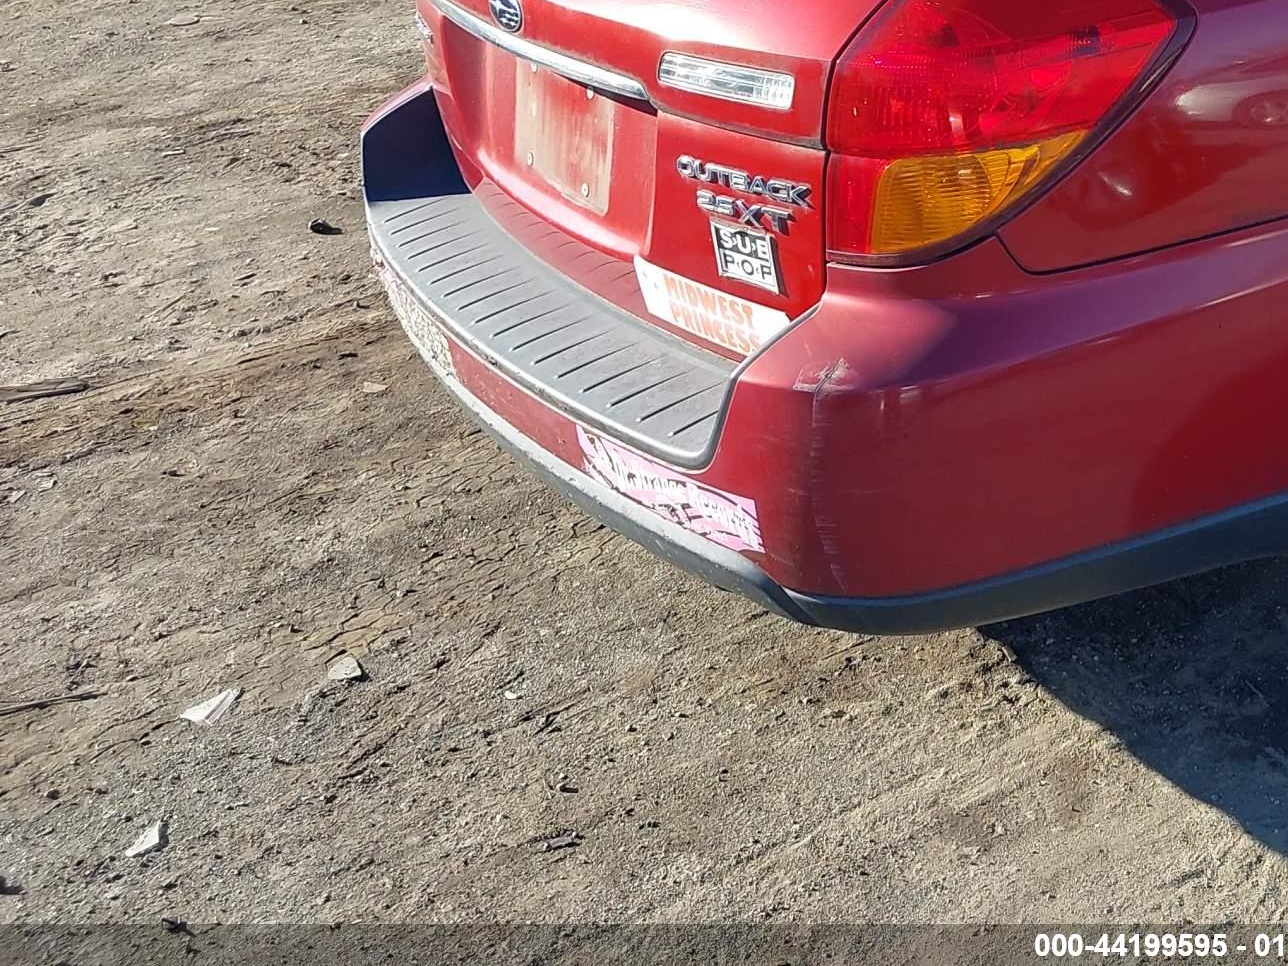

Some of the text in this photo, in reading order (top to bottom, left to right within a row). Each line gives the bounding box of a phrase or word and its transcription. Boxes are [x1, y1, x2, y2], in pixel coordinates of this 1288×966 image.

[676, 154, 813, 209] OUTBACK
[663, 274, 753, 328] MIDWEST
[669, 300, 761, 352] PRINCESS
